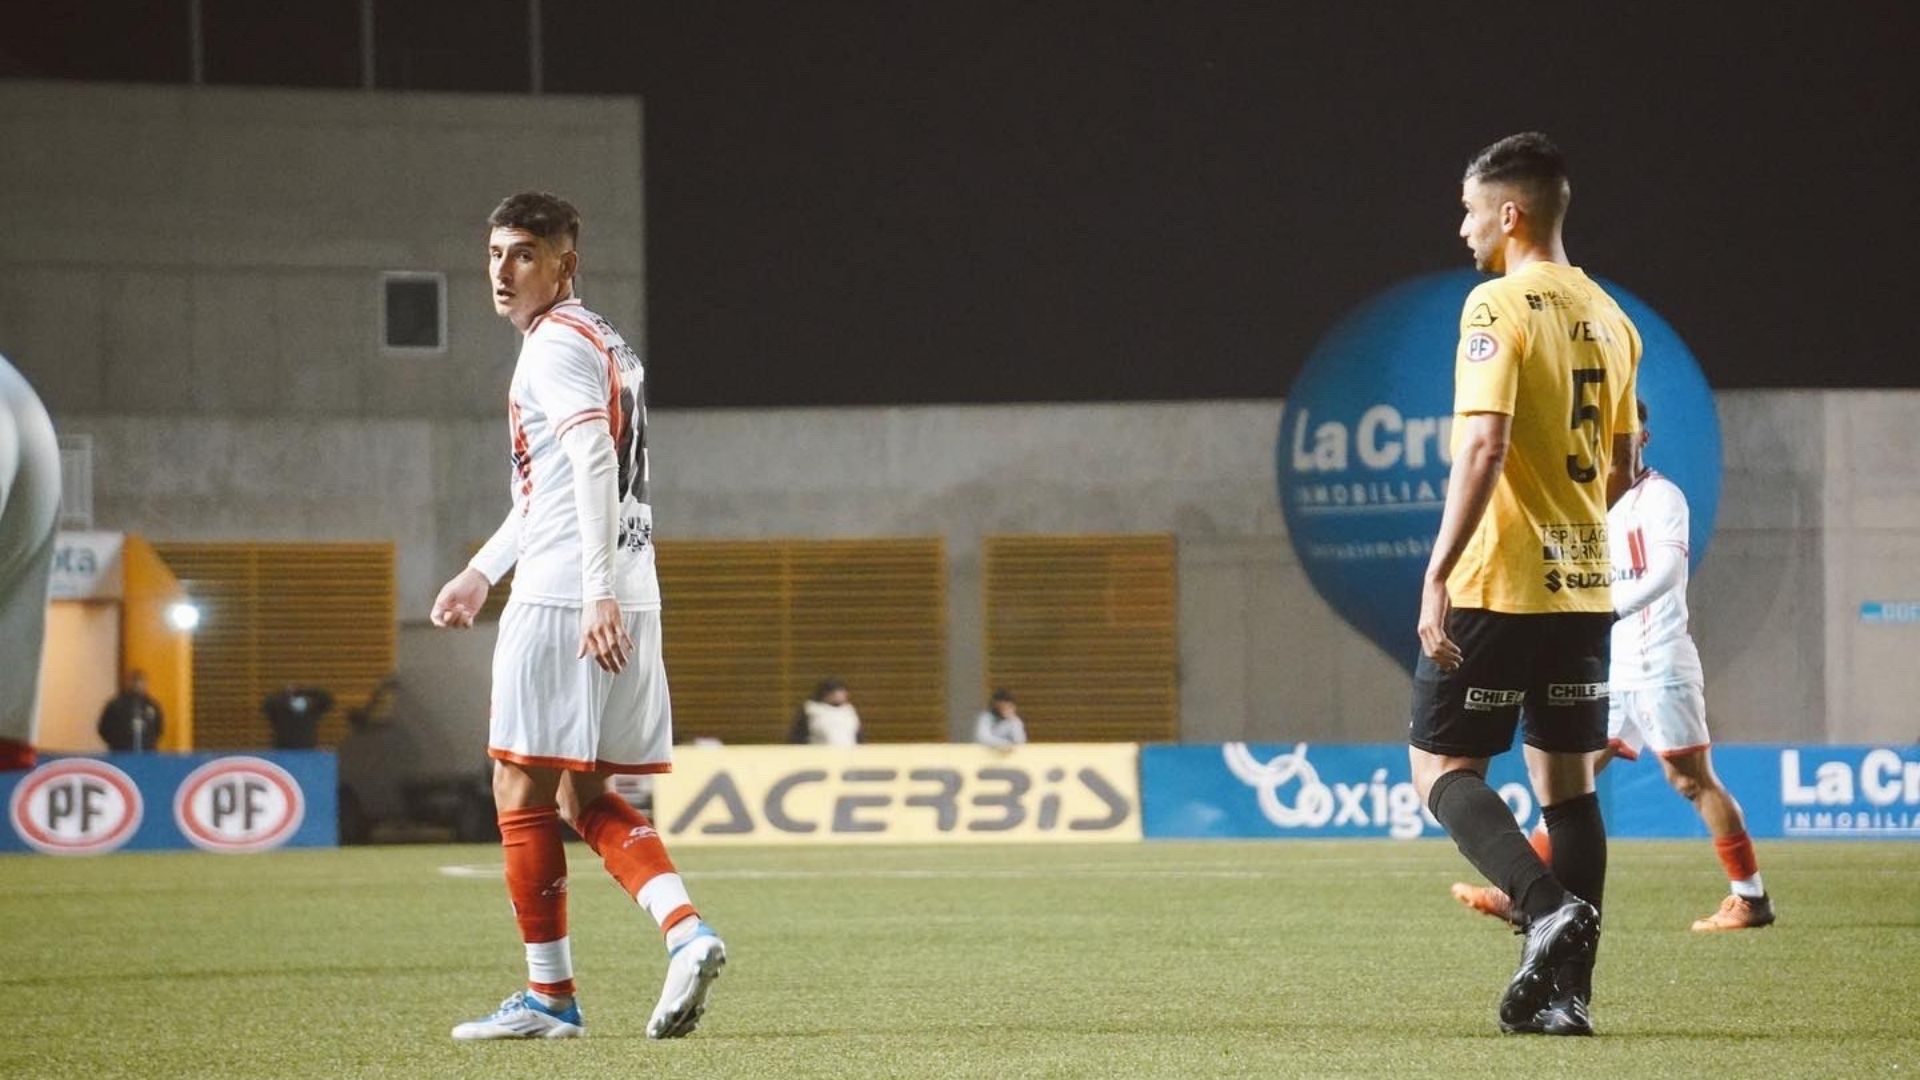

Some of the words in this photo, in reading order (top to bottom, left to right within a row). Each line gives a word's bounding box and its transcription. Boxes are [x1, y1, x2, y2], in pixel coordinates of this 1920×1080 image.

[1470, 338, 1490, 356] PF
[1293, 408, 1348, 471] La
[1566, 368, 1607, 484] 5
[1781, 749, 1854, 805] La
[48, 783, 106, 833] PF
[211, 781, 269, 830] PF
